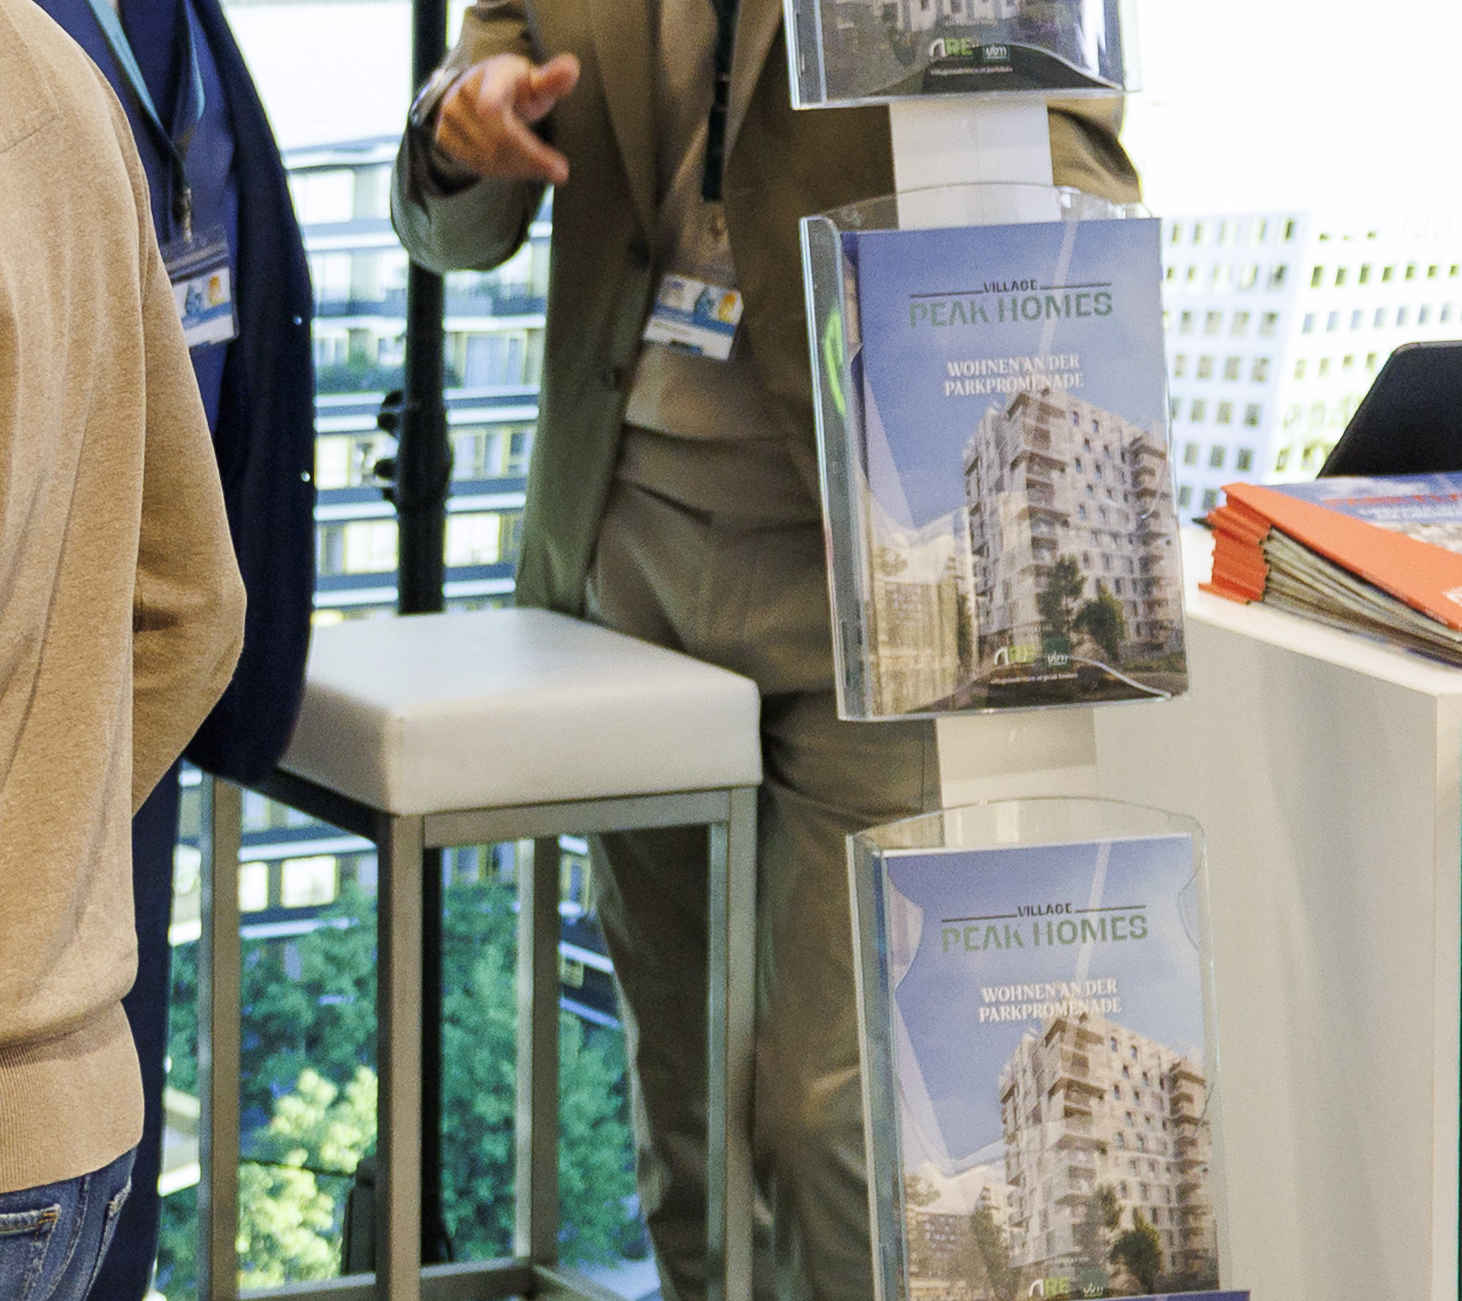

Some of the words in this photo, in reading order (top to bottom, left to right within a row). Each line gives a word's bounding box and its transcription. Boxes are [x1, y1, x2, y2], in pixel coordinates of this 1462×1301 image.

[982, 278, 1038, 294] VILLAGE
[909, 296, 995, 328] PEAK
[997, 291, 1114, 323] HOMES
[946, 359, 1021, 378] WOHNEN
[1023, 357, 1047, 374] AN
[1047, 354, 1080, 372] DER
[943, 372, 1084, 397] PARKPROMENADE
[1015, 902, 1074, 917] VILLAGE
[940, 921, 1026, 954] PEAK
[1032, 915, 1149, 948] HOMES
[980, 983, 1057, 1003] WOHNEN
[1059, 981, 1083, 999] AN
[1084, 978, 1118, 997] DER
[977, 996, 1122, 1023] PARKPROMENADE
